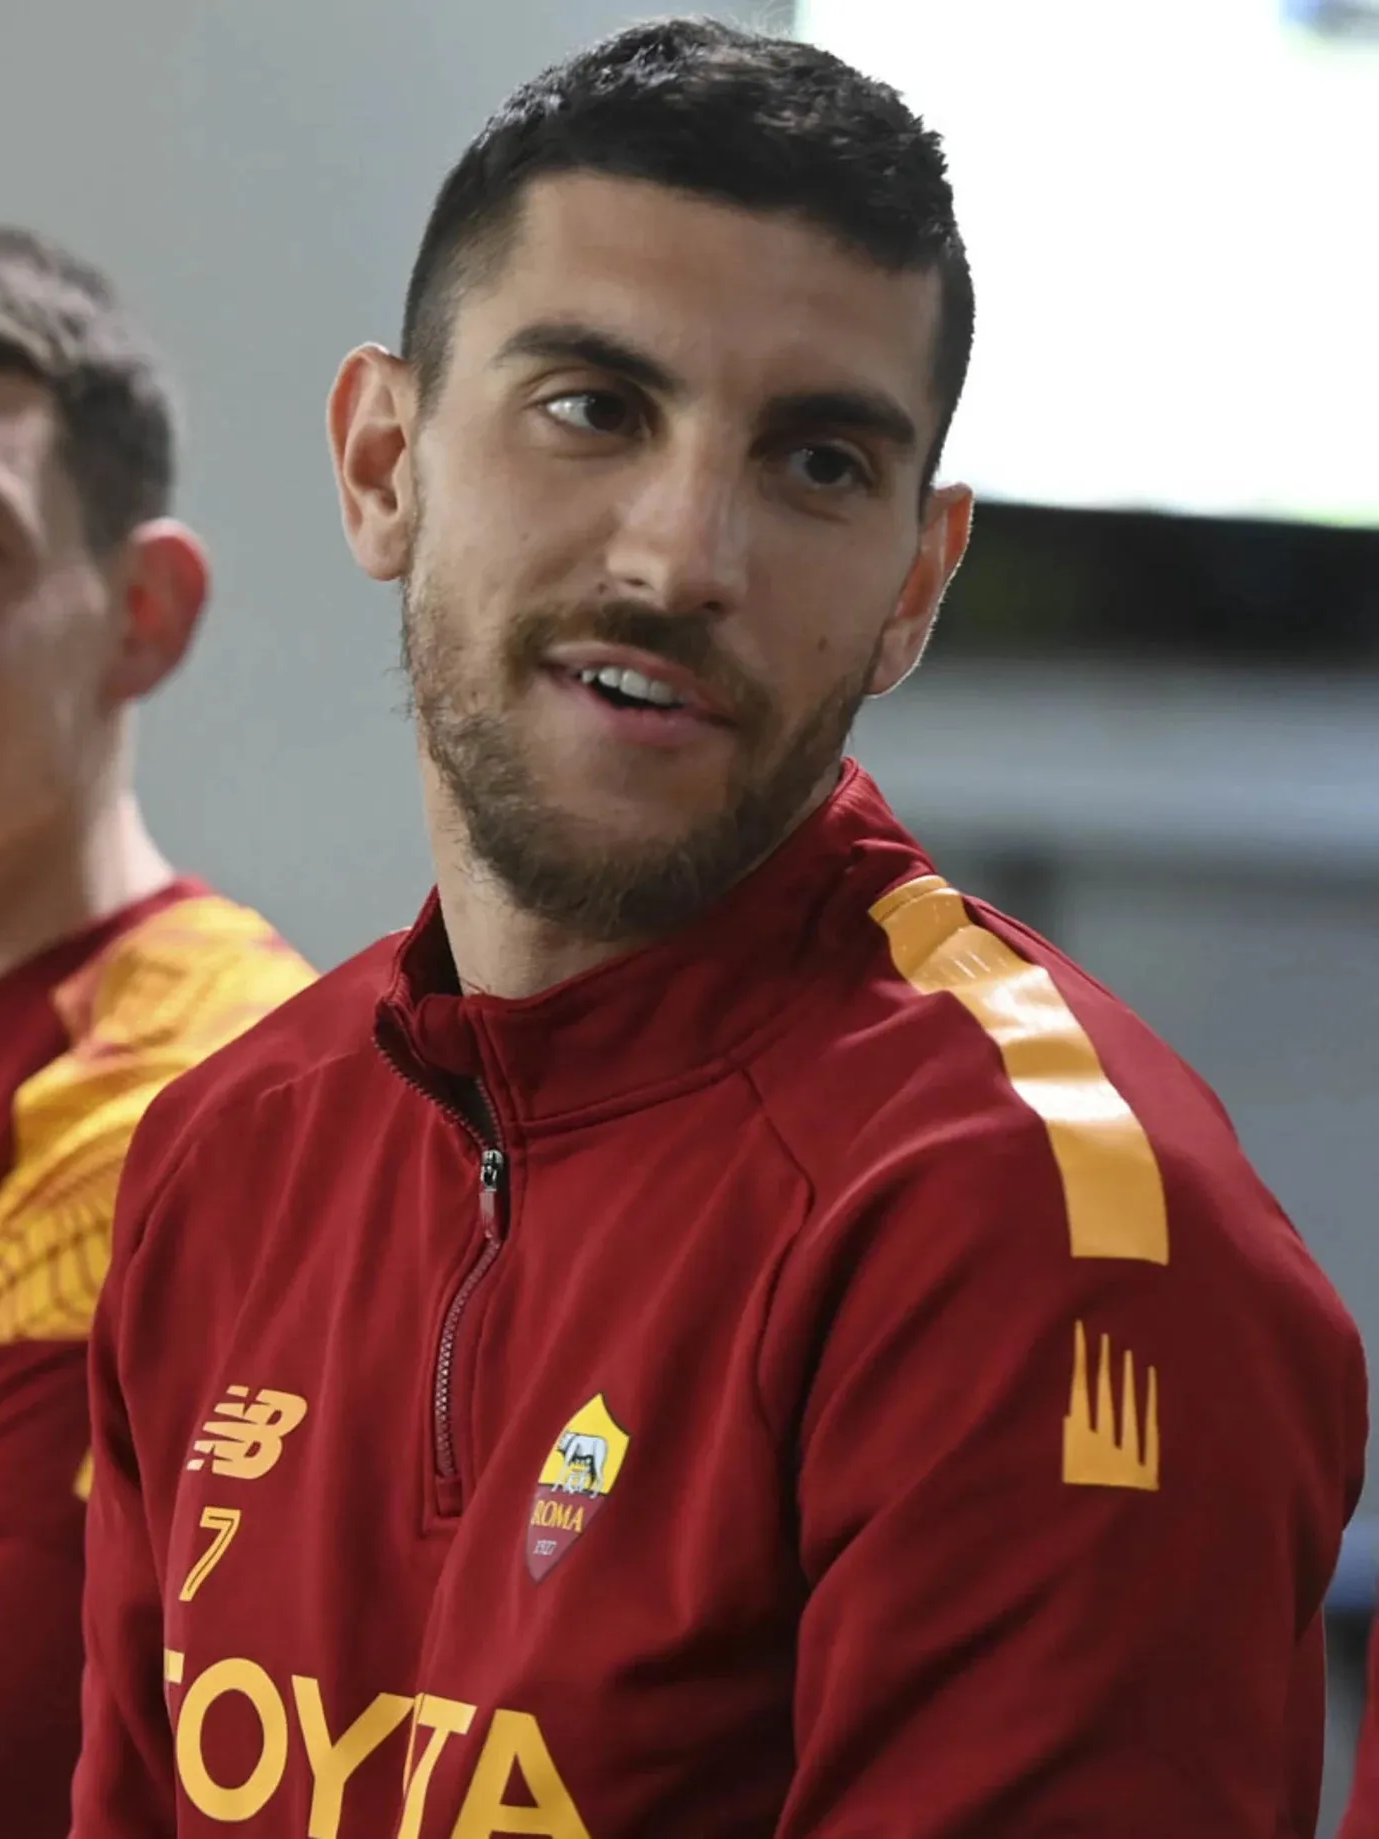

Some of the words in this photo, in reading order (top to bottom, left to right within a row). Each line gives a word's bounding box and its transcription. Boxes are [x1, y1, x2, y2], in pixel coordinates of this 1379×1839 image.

[179, 1506, 241, 1602] 7
[531, 1500, 584, 1533] ROMA
[164, 1648, 591, 1839] OYTA
